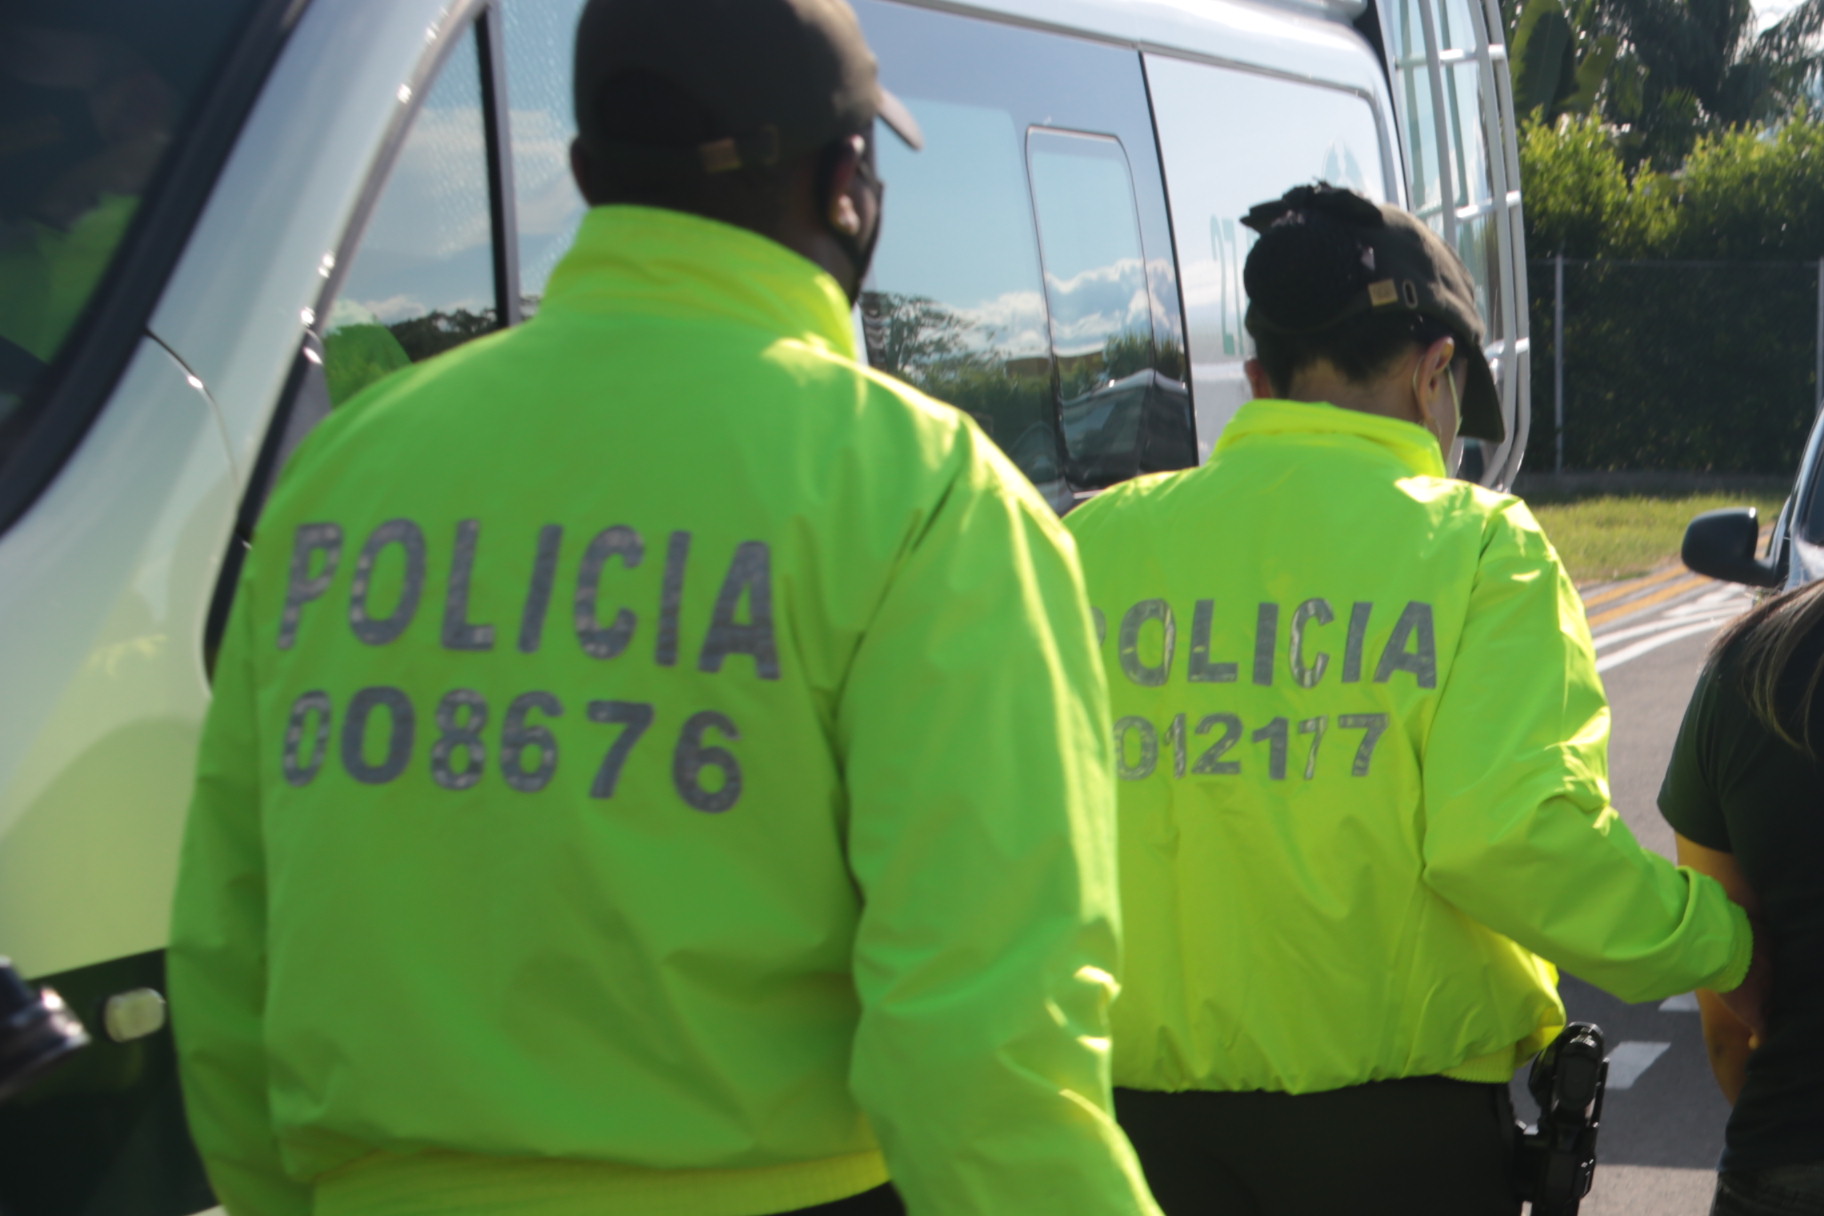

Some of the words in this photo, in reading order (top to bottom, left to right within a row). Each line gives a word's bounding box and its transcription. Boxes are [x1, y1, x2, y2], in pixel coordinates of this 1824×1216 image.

[275, 517, 781, 681] POLICIA
[281, 685, 743, 815] 008676
[1113, 712, 1391, 782] 012177
